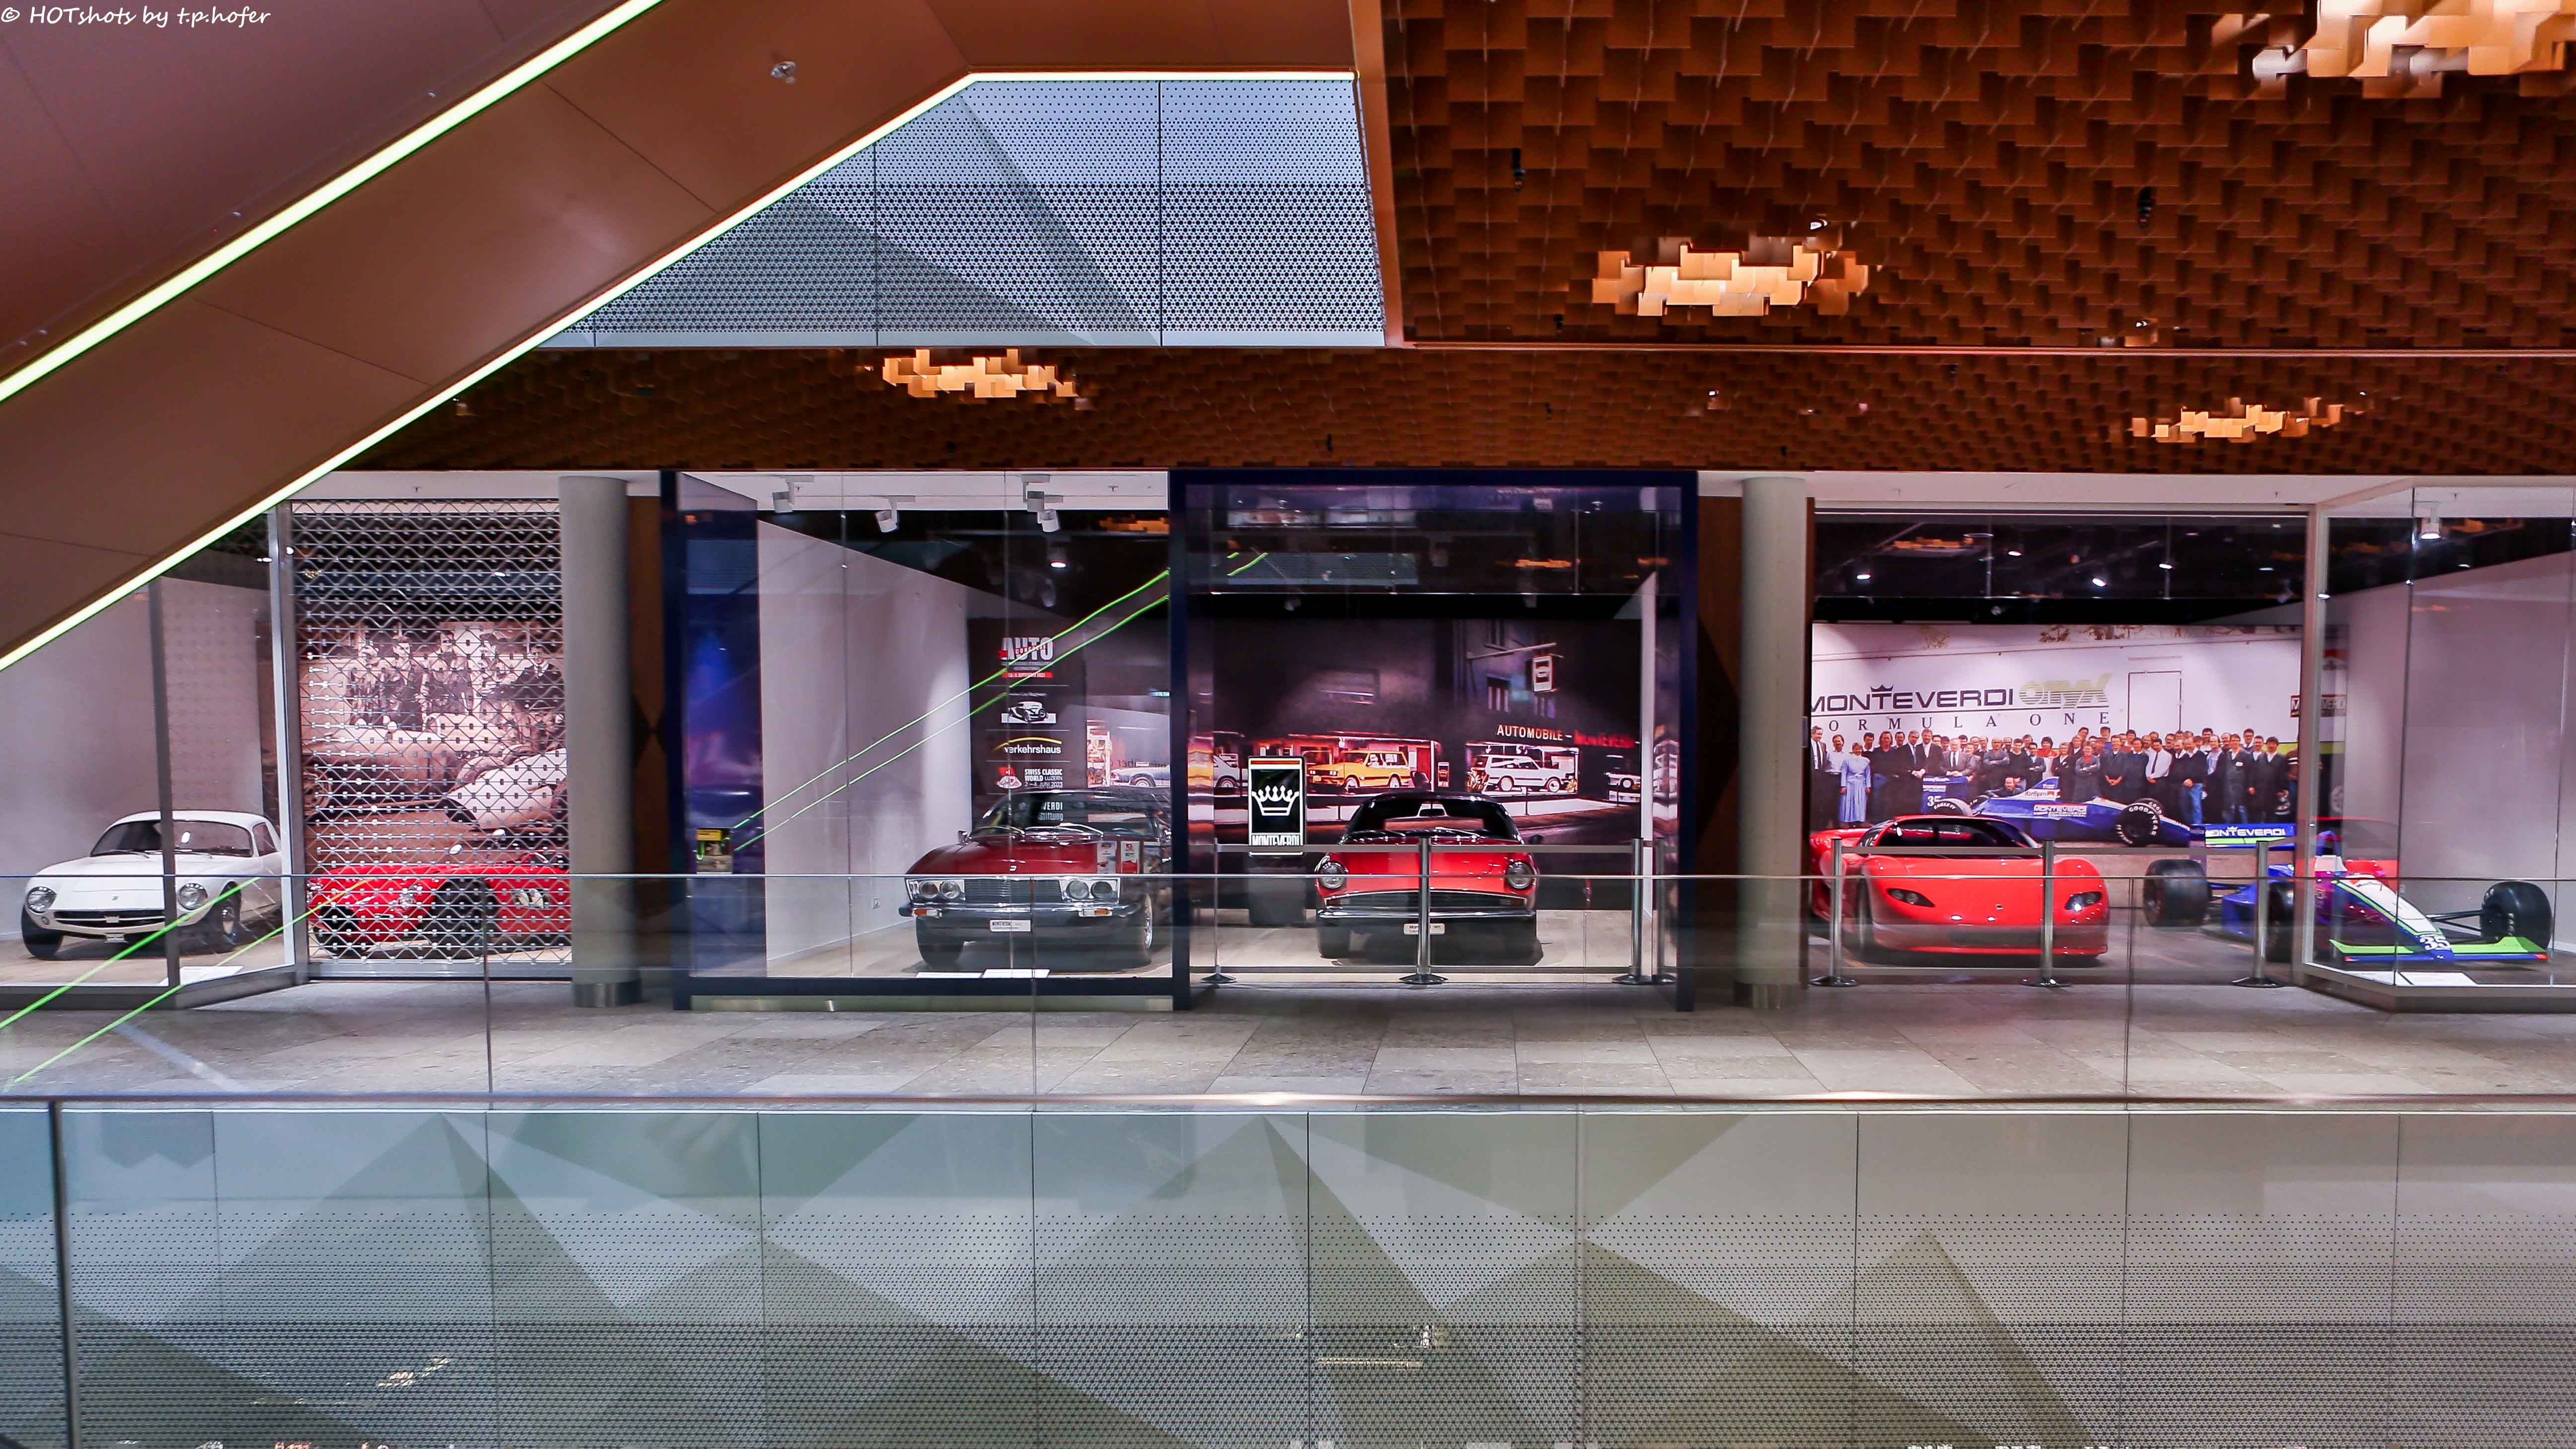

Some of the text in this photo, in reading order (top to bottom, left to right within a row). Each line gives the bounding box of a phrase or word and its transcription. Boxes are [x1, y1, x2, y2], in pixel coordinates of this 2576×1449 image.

[1001, 637, 1053, 660] AUTO
[1829, 711, 2109, 731] ORMULA ONE
[1497, 724, 1563, 741] AUTOMOBILE
[1004, 744, 1061, 754] verkehrshaus
[2419, 935, 2451, 951] 35
